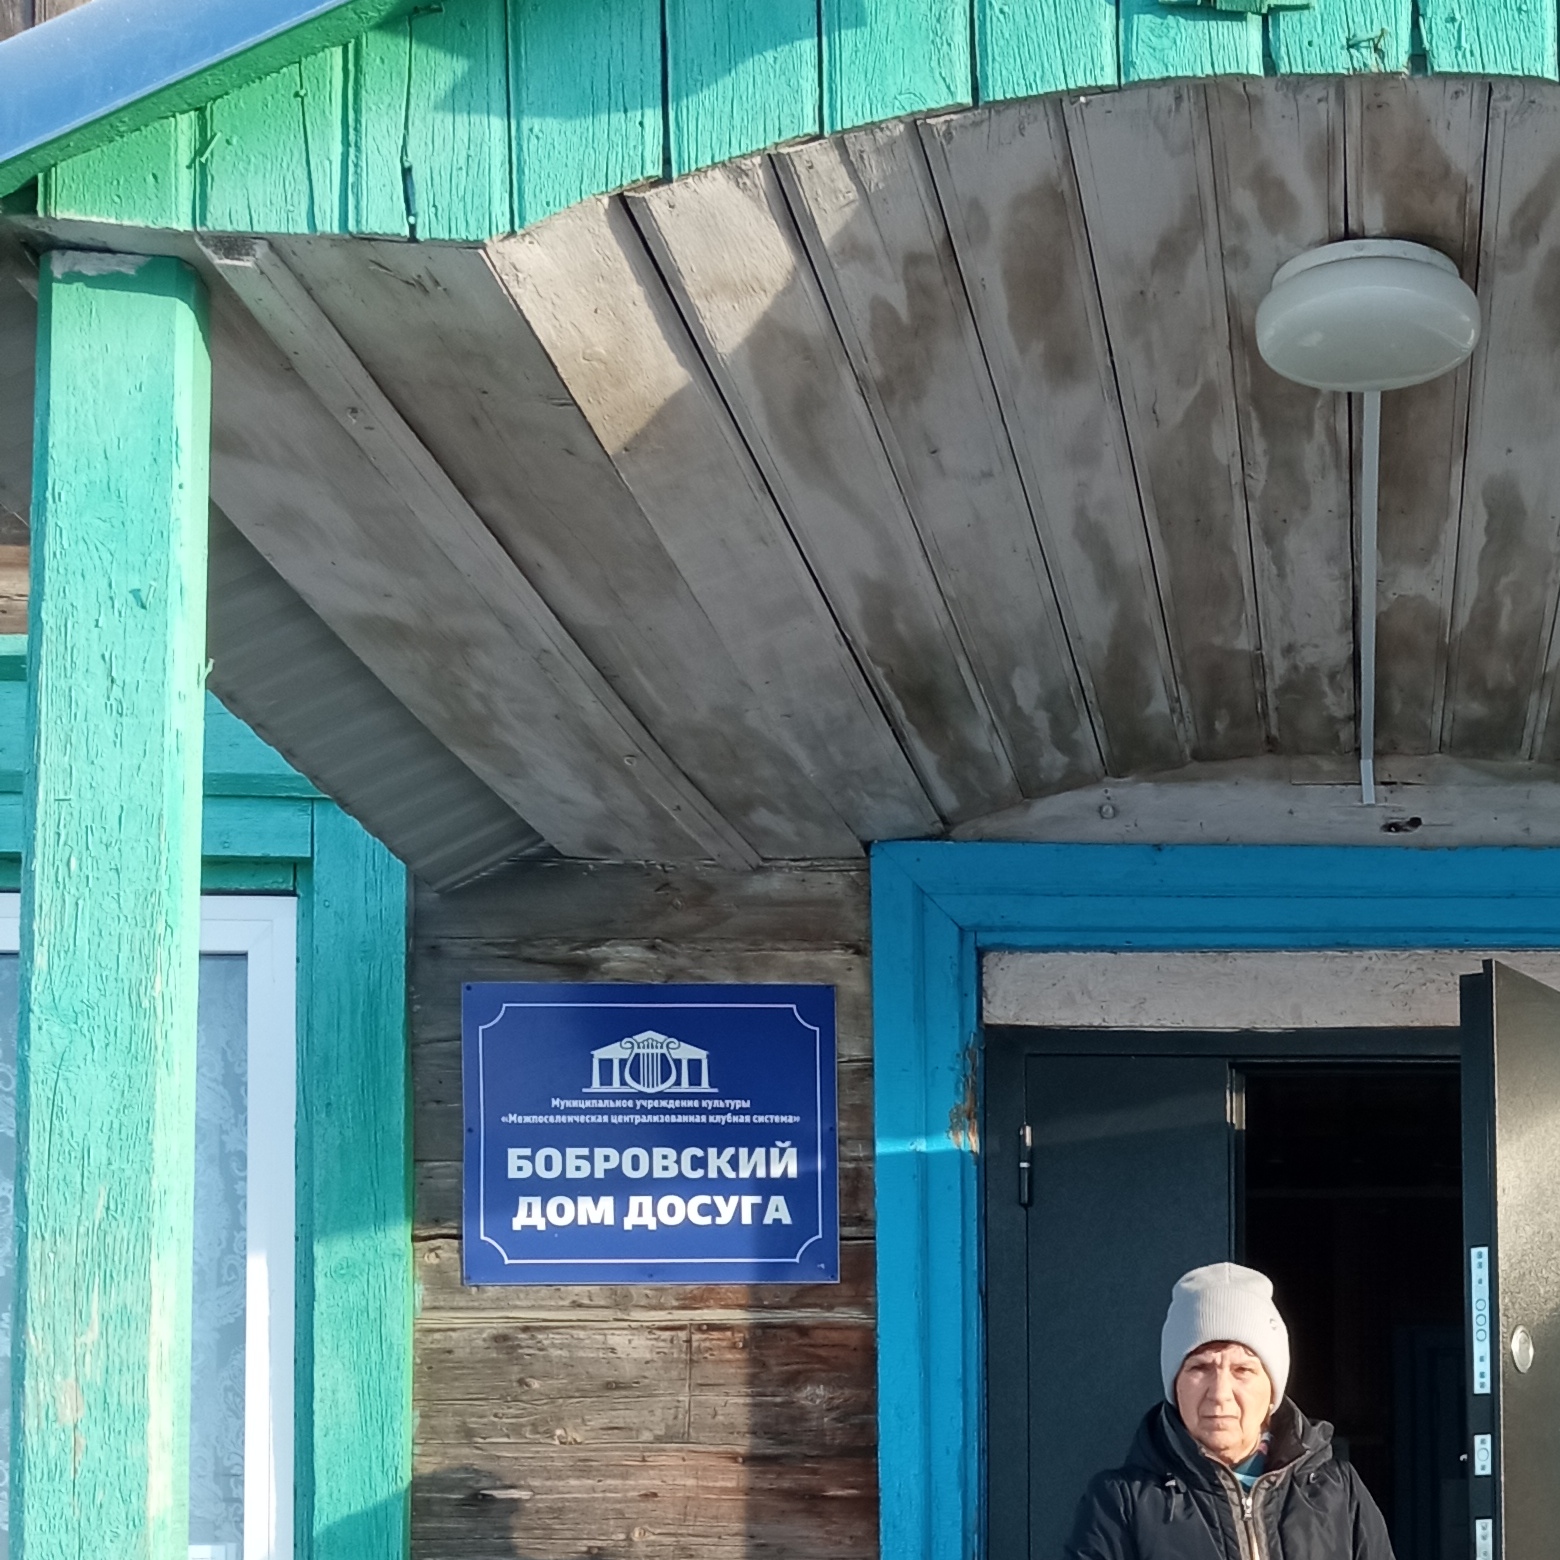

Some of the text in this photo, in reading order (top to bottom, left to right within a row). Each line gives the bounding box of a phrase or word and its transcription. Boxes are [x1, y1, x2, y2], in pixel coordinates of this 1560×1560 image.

[551, 1097, 751, 1110] Муниципальное учреждение культуры
[610, 1114, 707, 1125] централизованная
[708, 1112, 751, 1125] клубная
[752, 1114, 801, 1124] система»
[507, 1140, 798, 1179] БОБРОВСКИЙ
[512, 1195, 793, 1231] ДОМ ДОСУГА
